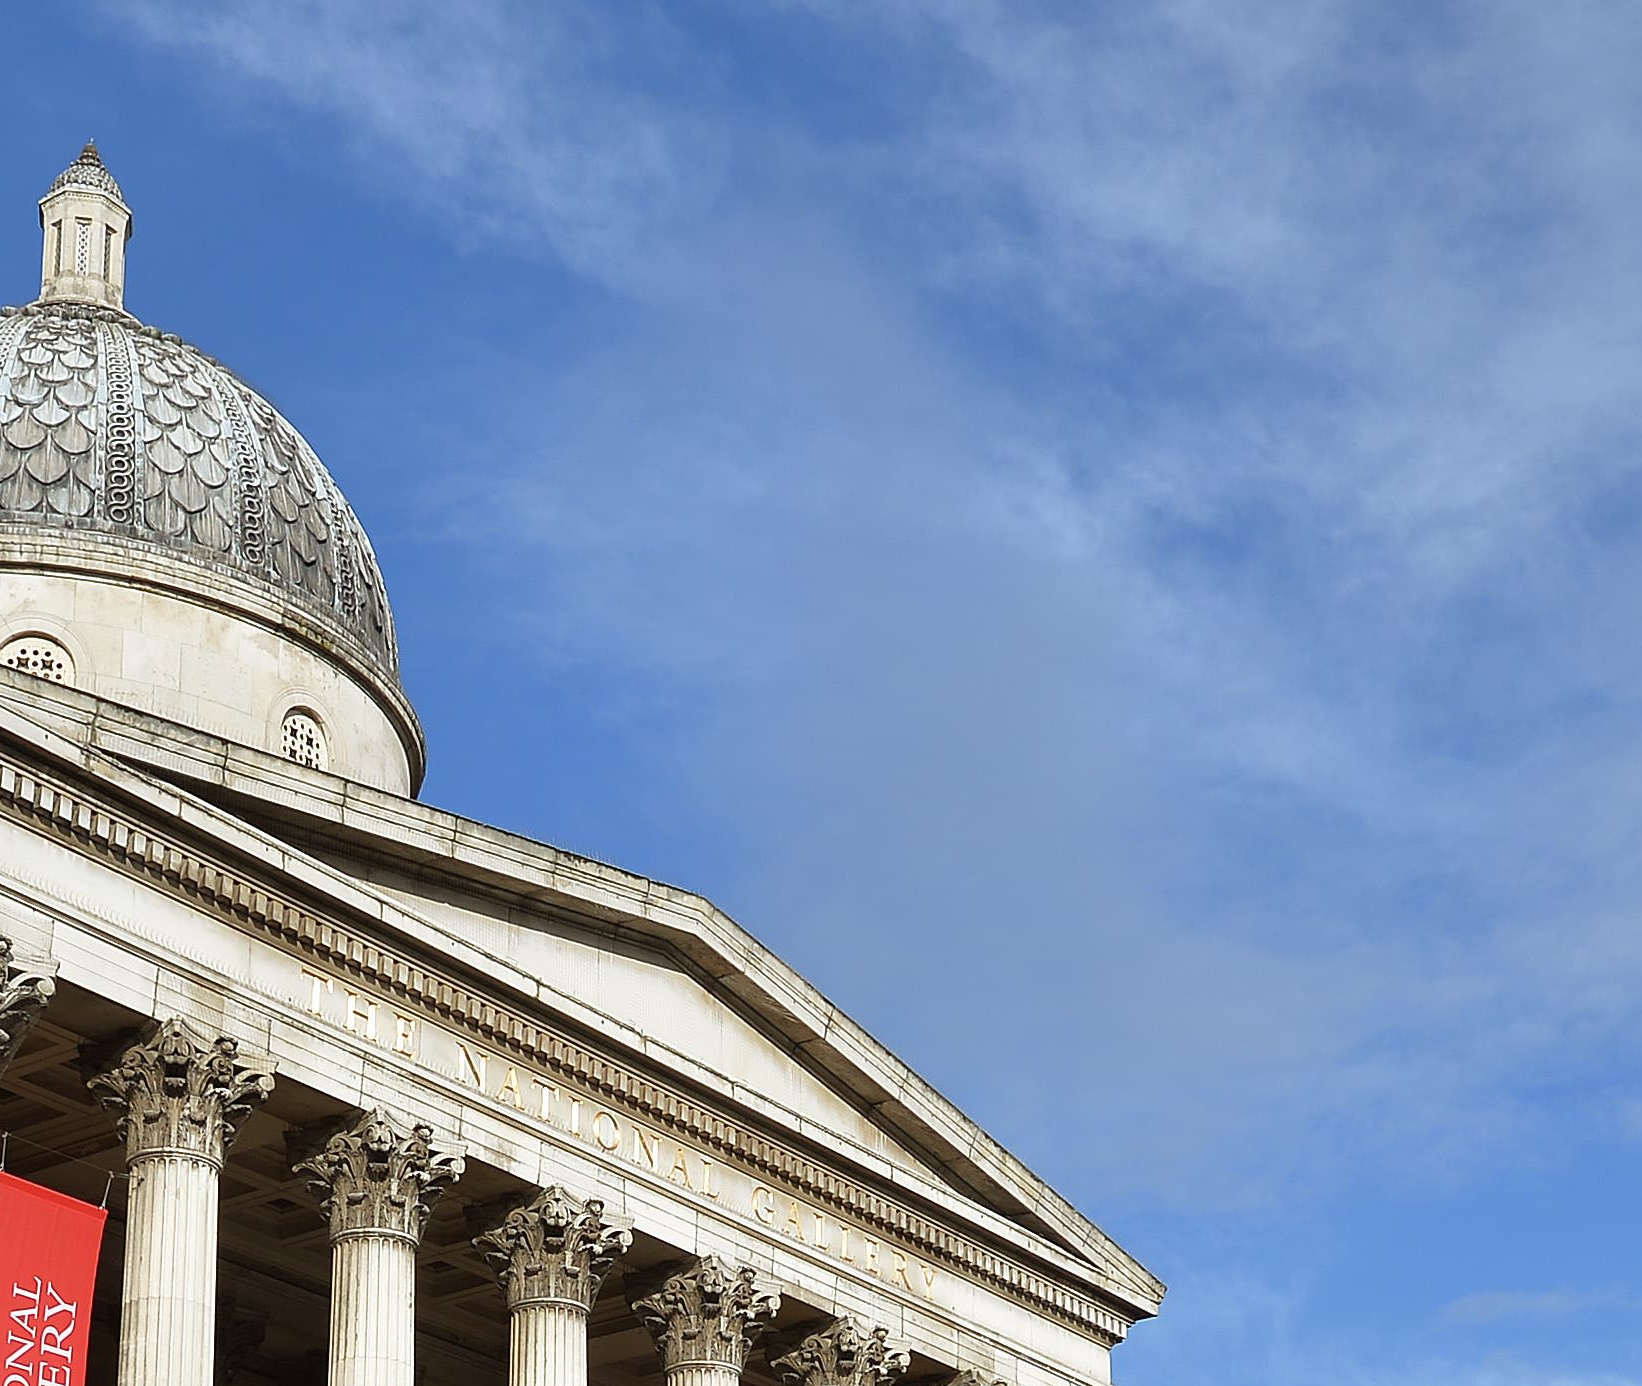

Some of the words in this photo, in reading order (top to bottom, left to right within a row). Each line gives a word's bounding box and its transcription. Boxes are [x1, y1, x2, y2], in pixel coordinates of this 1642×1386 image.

[299, 967, 416, 1060] THE
[454, 1041, 720, 1201] NATIONAL
[751, 1185, 938, 1301] GALLERY
